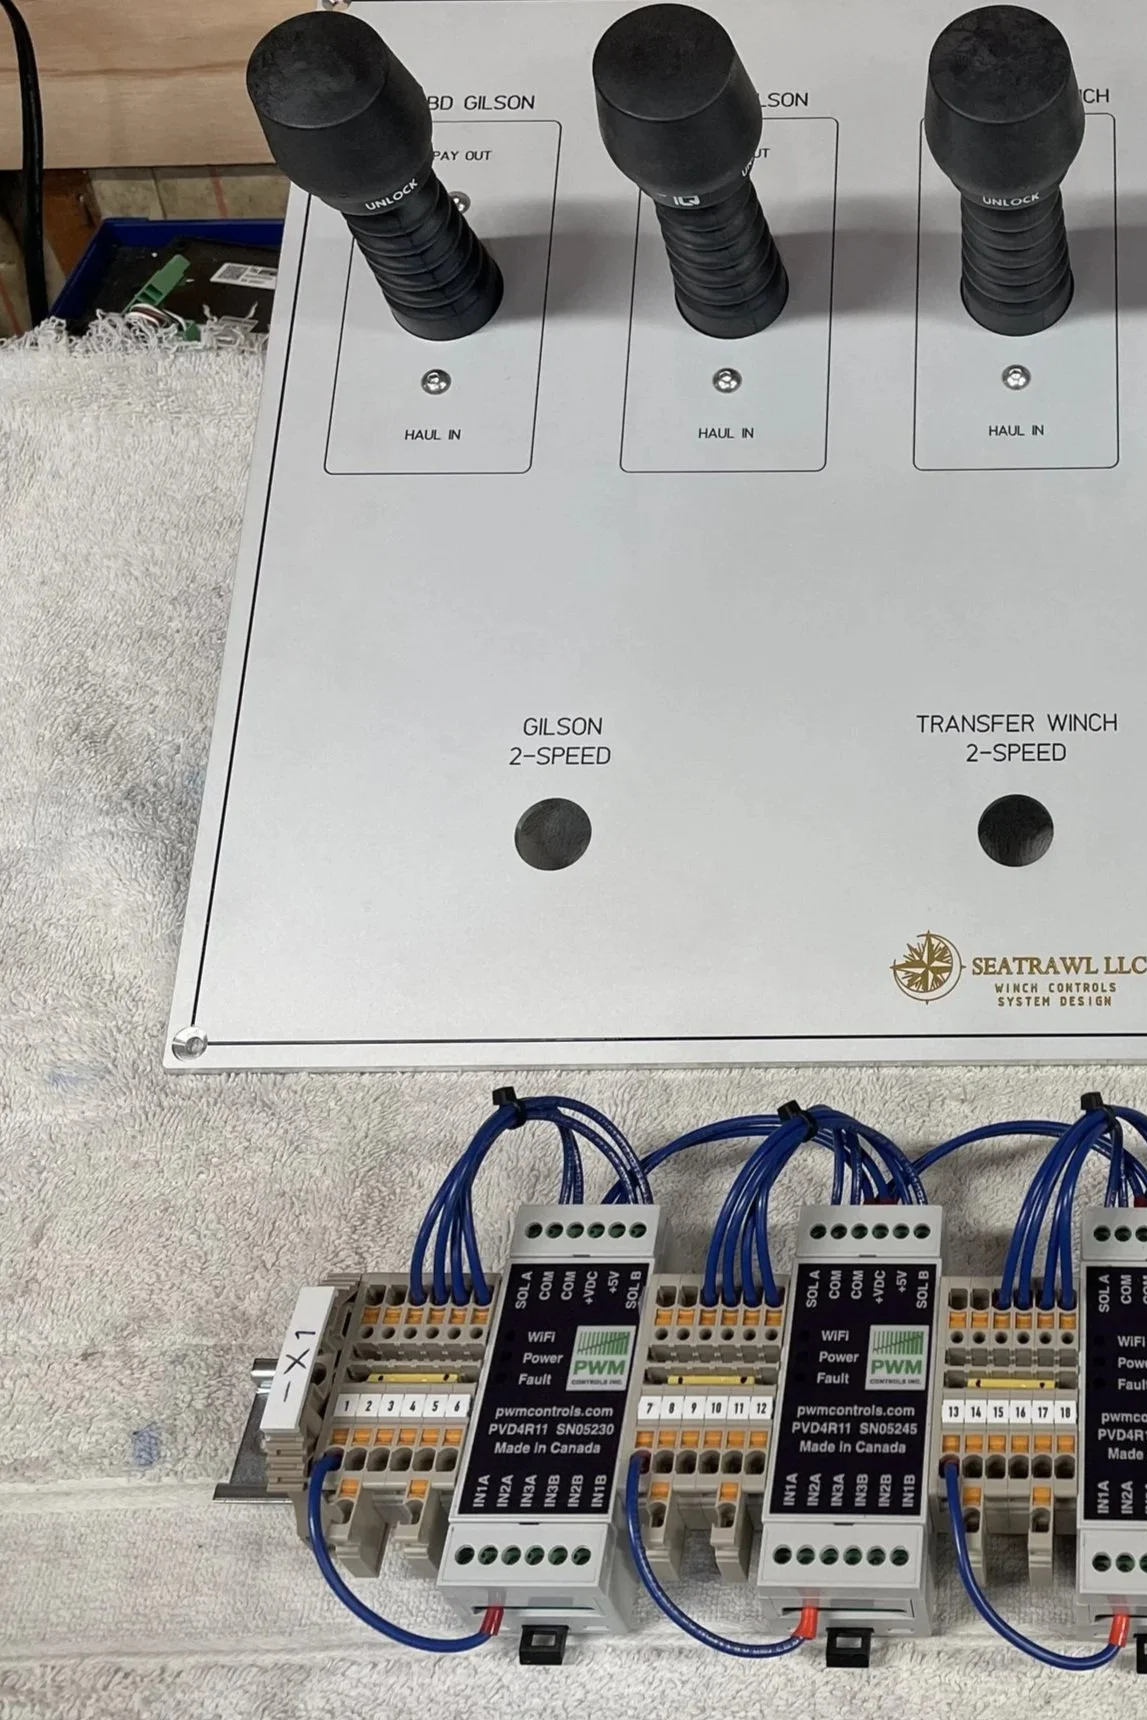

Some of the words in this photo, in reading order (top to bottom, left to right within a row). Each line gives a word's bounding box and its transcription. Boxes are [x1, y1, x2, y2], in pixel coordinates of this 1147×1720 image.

[464, 95, 535, 110] GILSON
[432, 150, 460, 161] PAY
[465, 150, 493, 161] OUT
[364, 177, 418, 211] UNLOCK
[672, 195, 701, 207] IQ
[982, 191, 1040, 207] UNLOCK
[404, 429, 441, 440] HAUL
[448, 429, 462, 440] IN
[698, 427, 735, 439] HAUL
[741, 427, 755, 439] IN
[988, 425, 1025, 436] HAUL
[1031, 425, 1045, 436] IN
[523, 717, 603, 736] GILSON
[916, 714, 1035, 733] TRANSFER
[1047, 713, 1118, 732] WINCH
[509, 746, 611, 765] 2-SPEED
[966, 743, 1067, 762] 2-SPEED
[971, 956, 1099, 976] SEATRAWL
[1104, 956, 1147, 975] LLC
[994, 982, 1039, 993] WINCH
[1049, 982, 1117, 993] CONTROLS
[997, 996, 1050, 1007] SYSTEM
[1059, 996, 1112, 1007] DESIGN
[539, 1271, 555, 1300] COM
[583, 1271, 599, 1305] +VDC
[828, 1270, 842, 1299] COM
[873, 1270, 886, 1304] +VDC
[1120, 1275, 1132, 1304] COM
[527, 1331, 556, 1343] WiFi
[821, 1330, 850, 1342] WiFi
[1117, 1336, 1146, 1348] WiFi
[522, 1353, 564, 1364] Power
[818, 1351, 860, 1363] Power
[573, 1360, 626, 1376] PWM
[870, 1360, 923, 1375] PWM
[518, 1374, 552, 1385] Fault
[816, 1372, 850, 1384] Fault
[495, 1405, 614, 1419] pwmcontrols.com
[711, 1402, 722, 1414] 10
[734, 1402, 744, 1414] 11
[756, 1402, 767, 1414] 12
[797, 1404, 916, 1418] pwmcontrols.com
[948, 1406, 959, 1418] 13
[971, 1406, 982, 1418] 14
[993, 1406, 1004, 1418] 15
[1015, 1407, 1026, 1418] 16
[1038, 1407, 1048, 1418] 17
[1060, 1407, 1071, 1418] 18
[488, 1423, 548, 1436] PVD4R11
[556, 1423, 615, 1436] SN05230
[791, 1421, 851, 1434] PVD4R11
[859, 1422, 918, 1435] SN05245
[494, 1442, 531, 1454] Made
[550, 1442, 601, 1454] Canada
[799, 1440, 836, 1453] Made
[855, 1441, 907, 1454] Canada
[1107, 1447, 1144, 1460] Made
[472, 1474, 491, 1507] IN1A
[496, 1474, 514, 1507] IN2A
[520, 1474, 538, 1507] IN3A
[544, 1474, 561, 1507] IN3B
[567, 1474, 584, 1507] IN2B
[591, 1474, 608, 1507] IN1B
[783, 1473, 798, 1506] IN1A
[806, 1473, 822, 1507] IN2A
[830, 1473, 846, 1507] IN3A
[854, 1473, 869, 1507] IN3B
[878, 1474, 893, 1507] IN2B
[902, 1474, 916, 1508] IN1B
[1097, 1480, 1110, 1514] IN1A
[1120, 1480, 1134, 1515] IN2A
